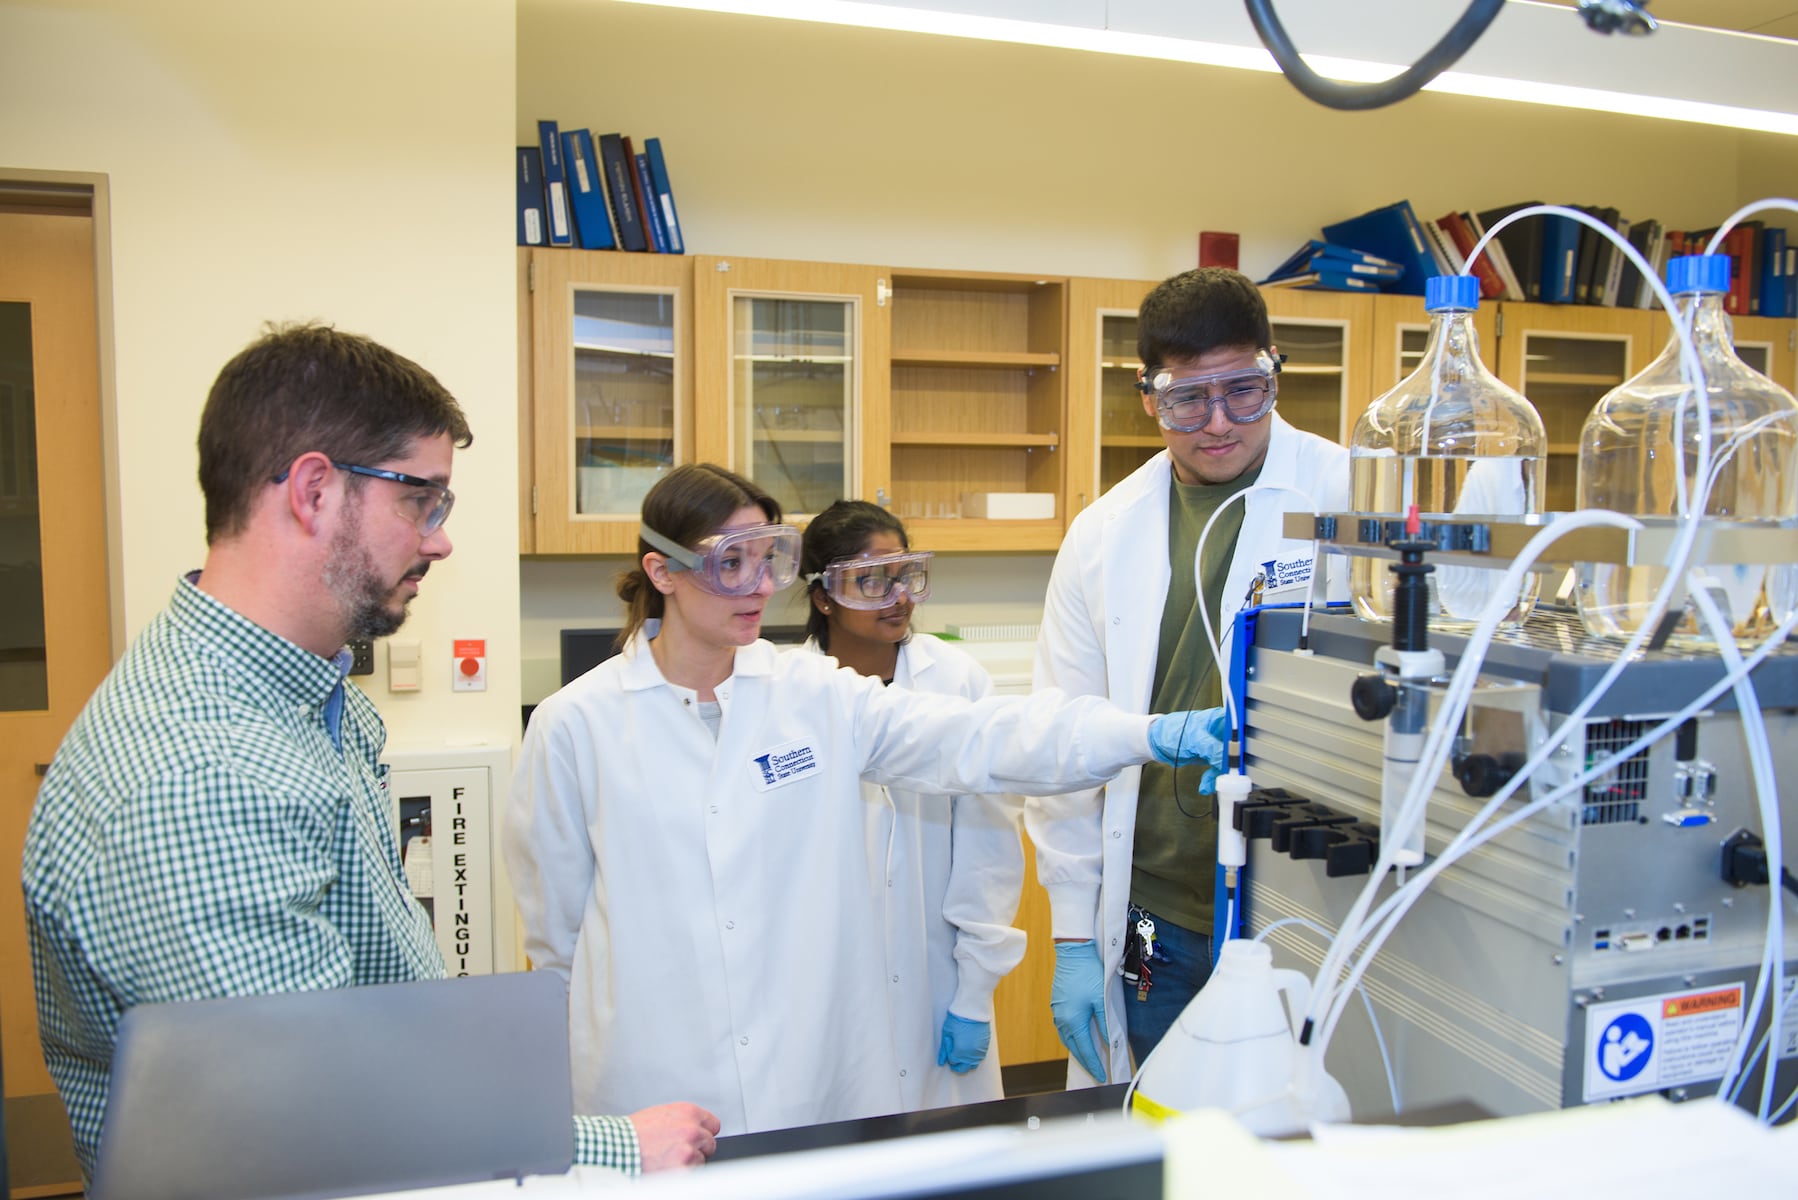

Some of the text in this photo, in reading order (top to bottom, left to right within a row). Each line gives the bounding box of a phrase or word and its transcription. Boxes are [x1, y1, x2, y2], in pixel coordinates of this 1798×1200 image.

[1277, 559, 1313, 572] Souther
[771, 746, 812, 765] Southern
[775, 755, 814, 772] Connecticut
[453, 787, 466, 845] FIRE
[1680, 993, 1736, 1011] WARNING
